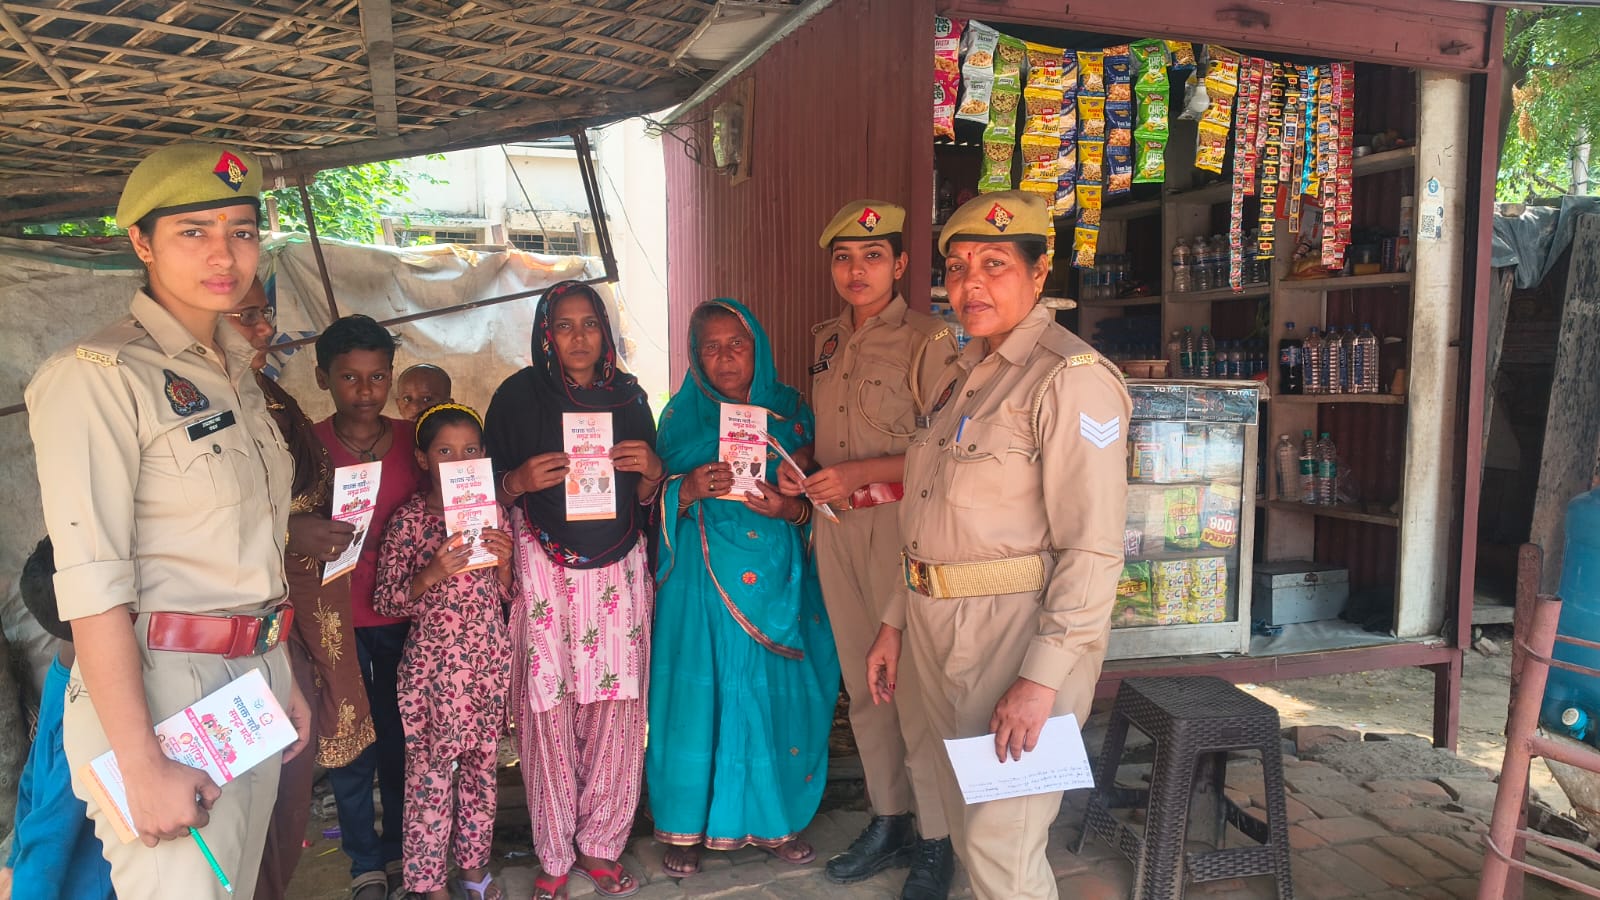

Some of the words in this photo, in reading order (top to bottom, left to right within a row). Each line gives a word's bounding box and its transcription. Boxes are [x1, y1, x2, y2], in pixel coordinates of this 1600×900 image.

[1225, 389, 1256, 397] TOTAL
[233, 695, 250, 719] सशक्त
[245, 716, 261, 735] नारी
